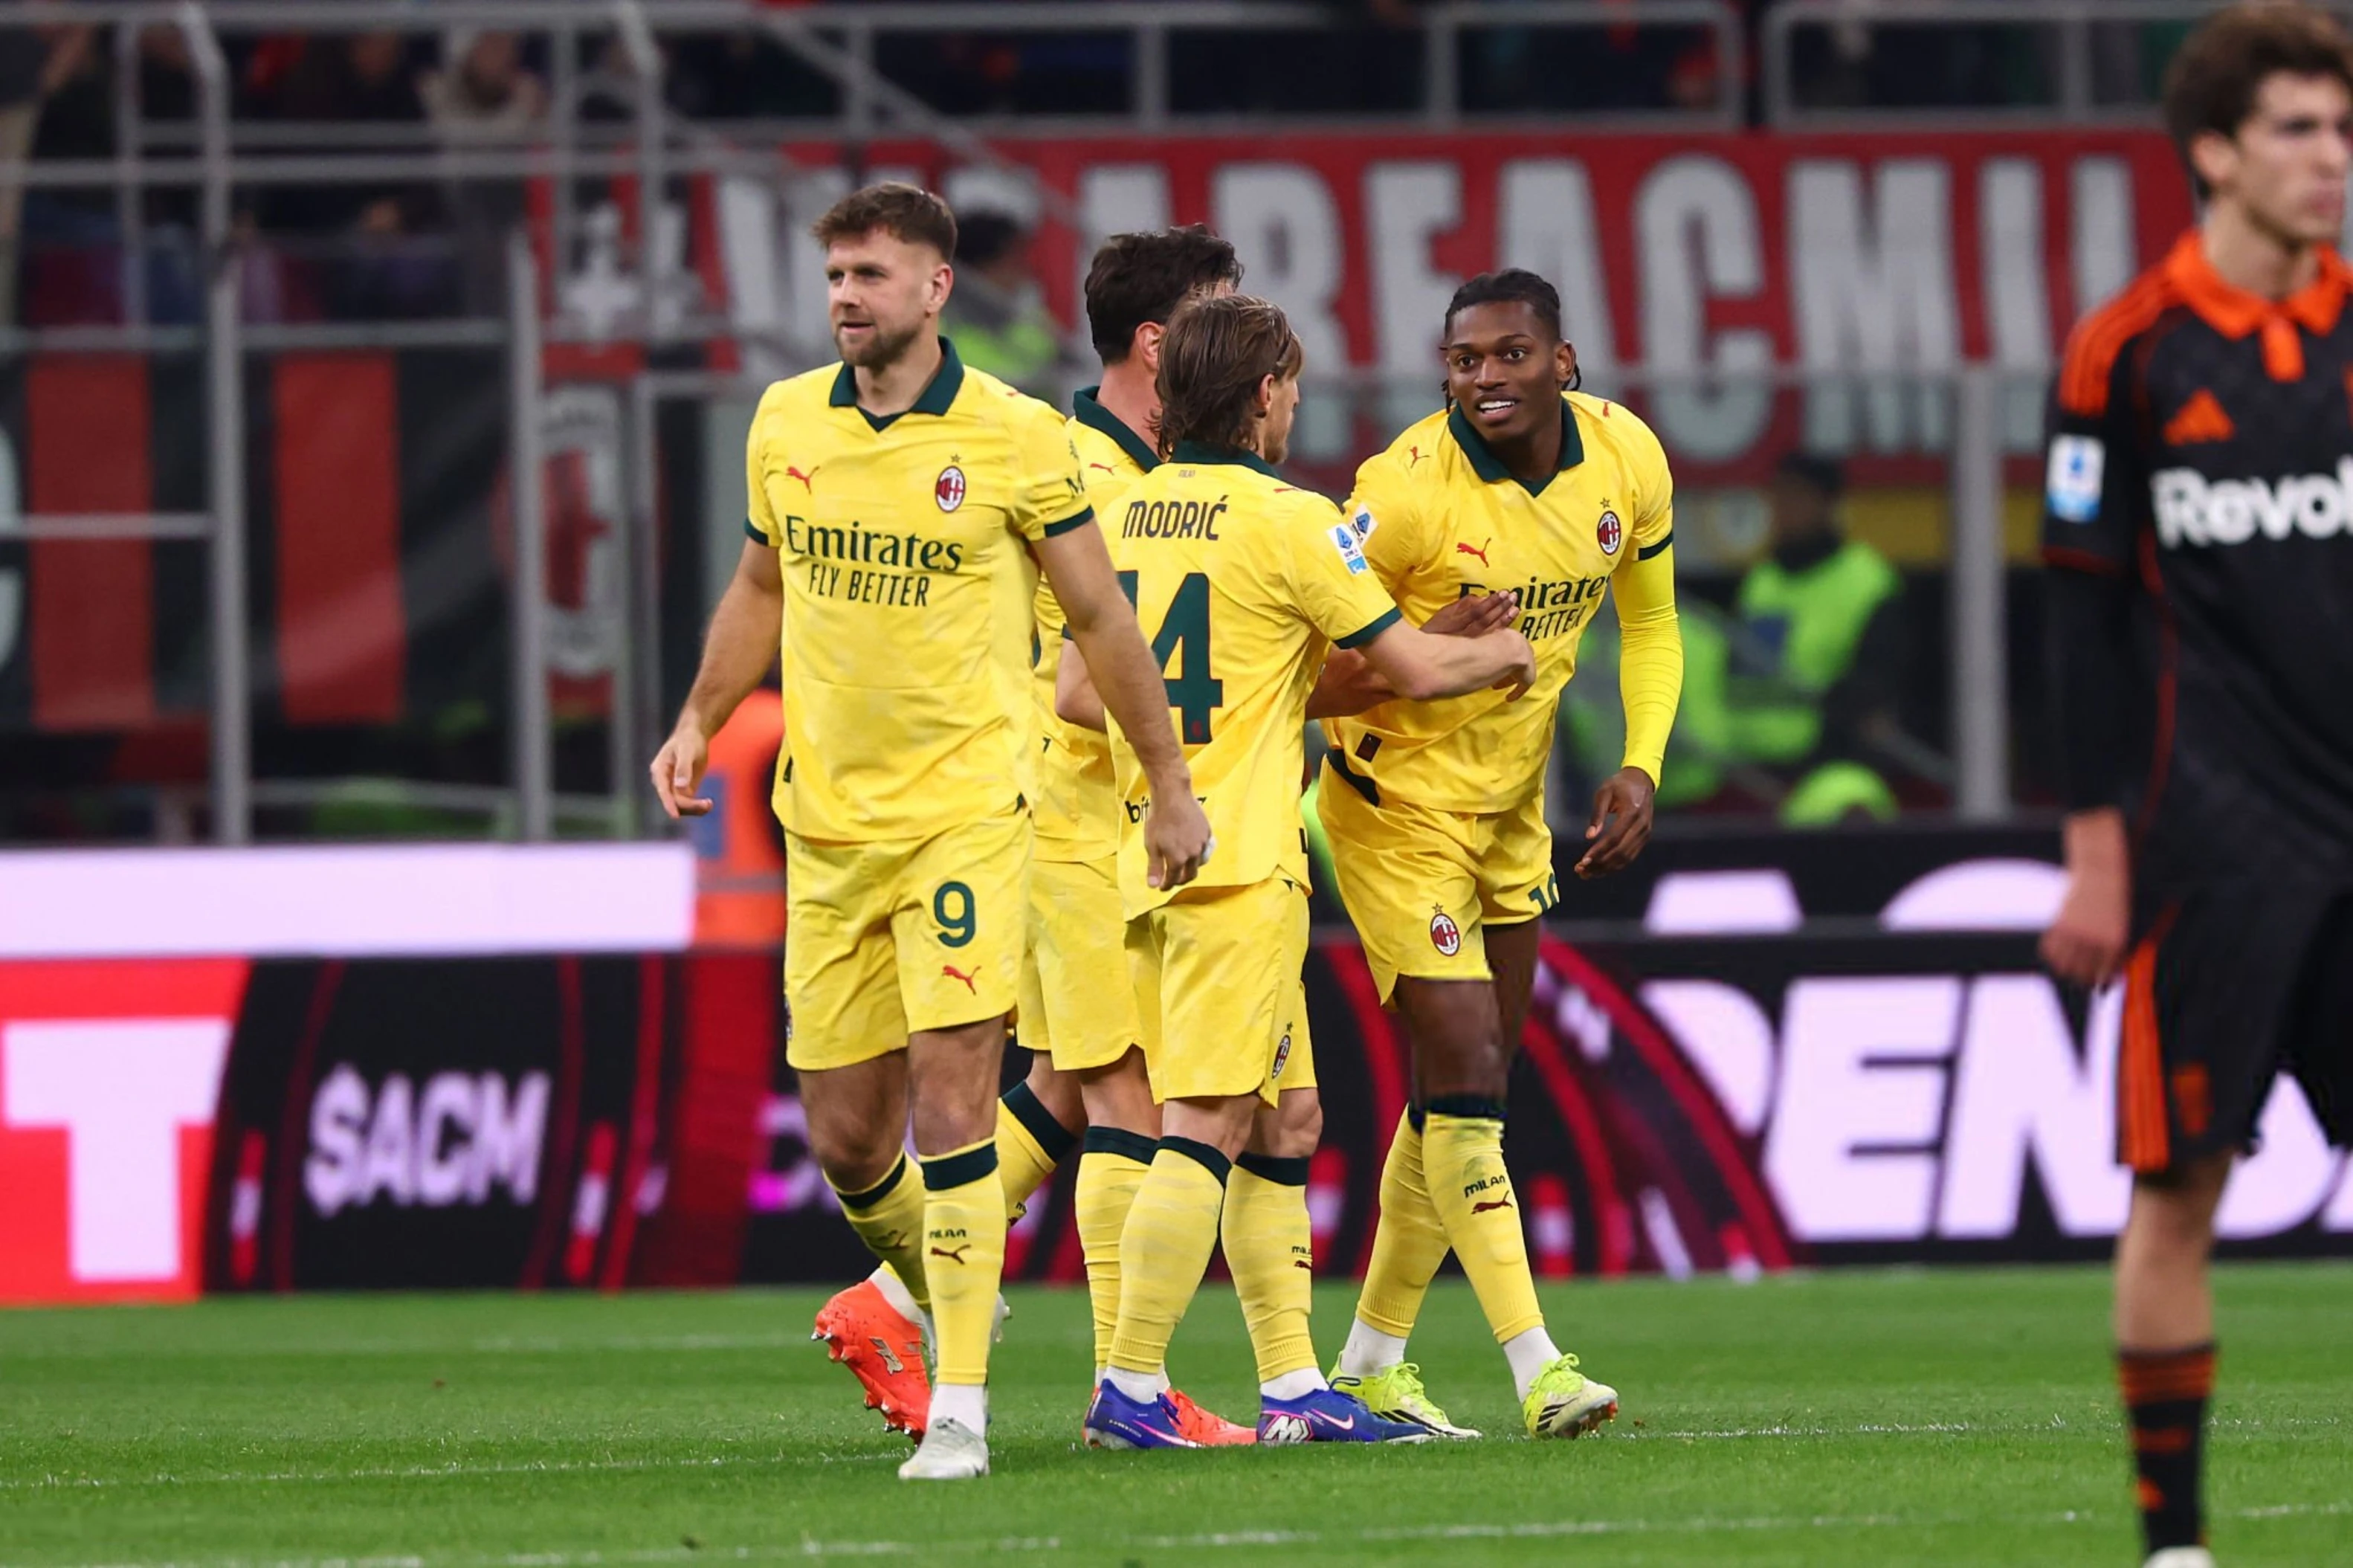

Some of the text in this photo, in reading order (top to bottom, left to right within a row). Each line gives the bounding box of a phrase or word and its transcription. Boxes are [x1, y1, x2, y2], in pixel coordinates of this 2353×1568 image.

[1123, 495, 1229, 541] MODRIĆ
[787, 514, 964, 572] Emirates
[809, 564, 930, 607] FLY BETTER
[1459, 573, 1610, 610] irate
[934, 881, 975, 948] 9
